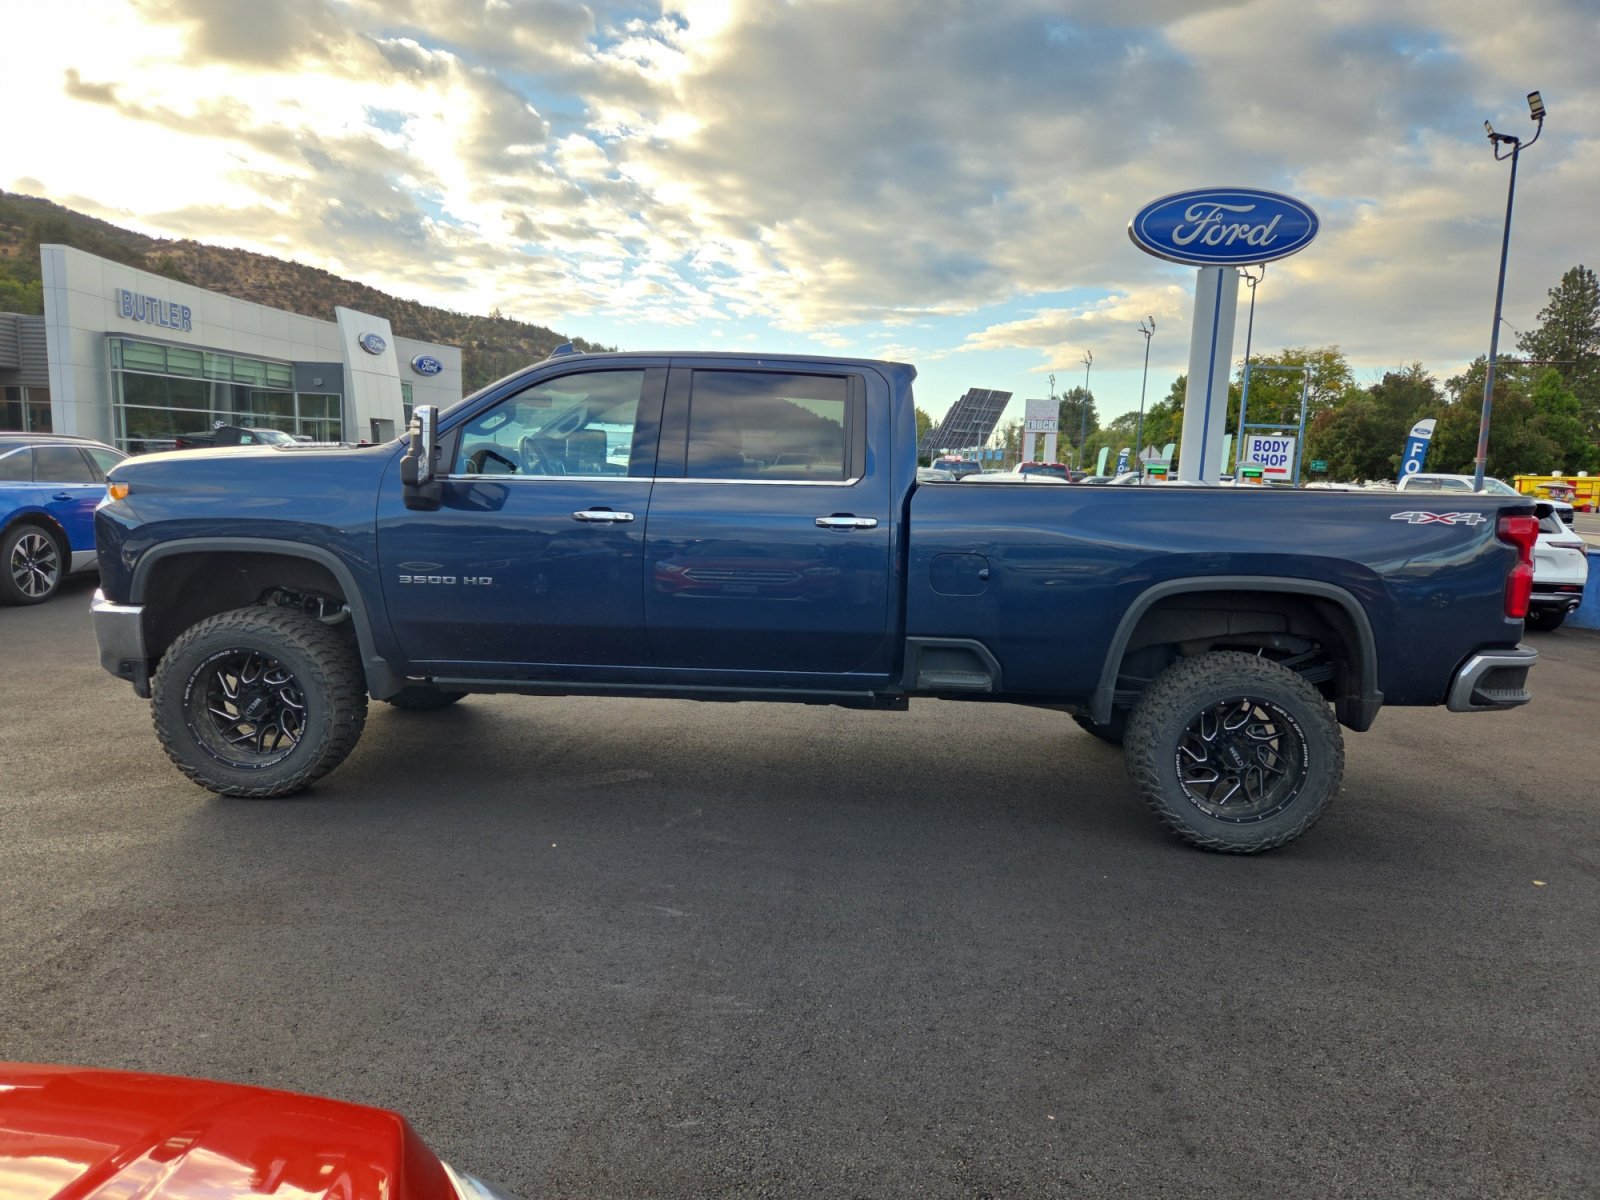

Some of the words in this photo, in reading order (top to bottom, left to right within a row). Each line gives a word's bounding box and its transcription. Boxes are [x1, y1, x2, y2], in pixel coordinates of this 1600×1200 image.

[1172, 202, 1283, 247] Ford
[119, 288, 192, 332] BUTLER
[421, 359, 439, 372] Ford
[1253, 439, 1289, 453] BODY
[1252, 453, 1287, 466] SHOP
[399, 575, 457, 585] 3500
